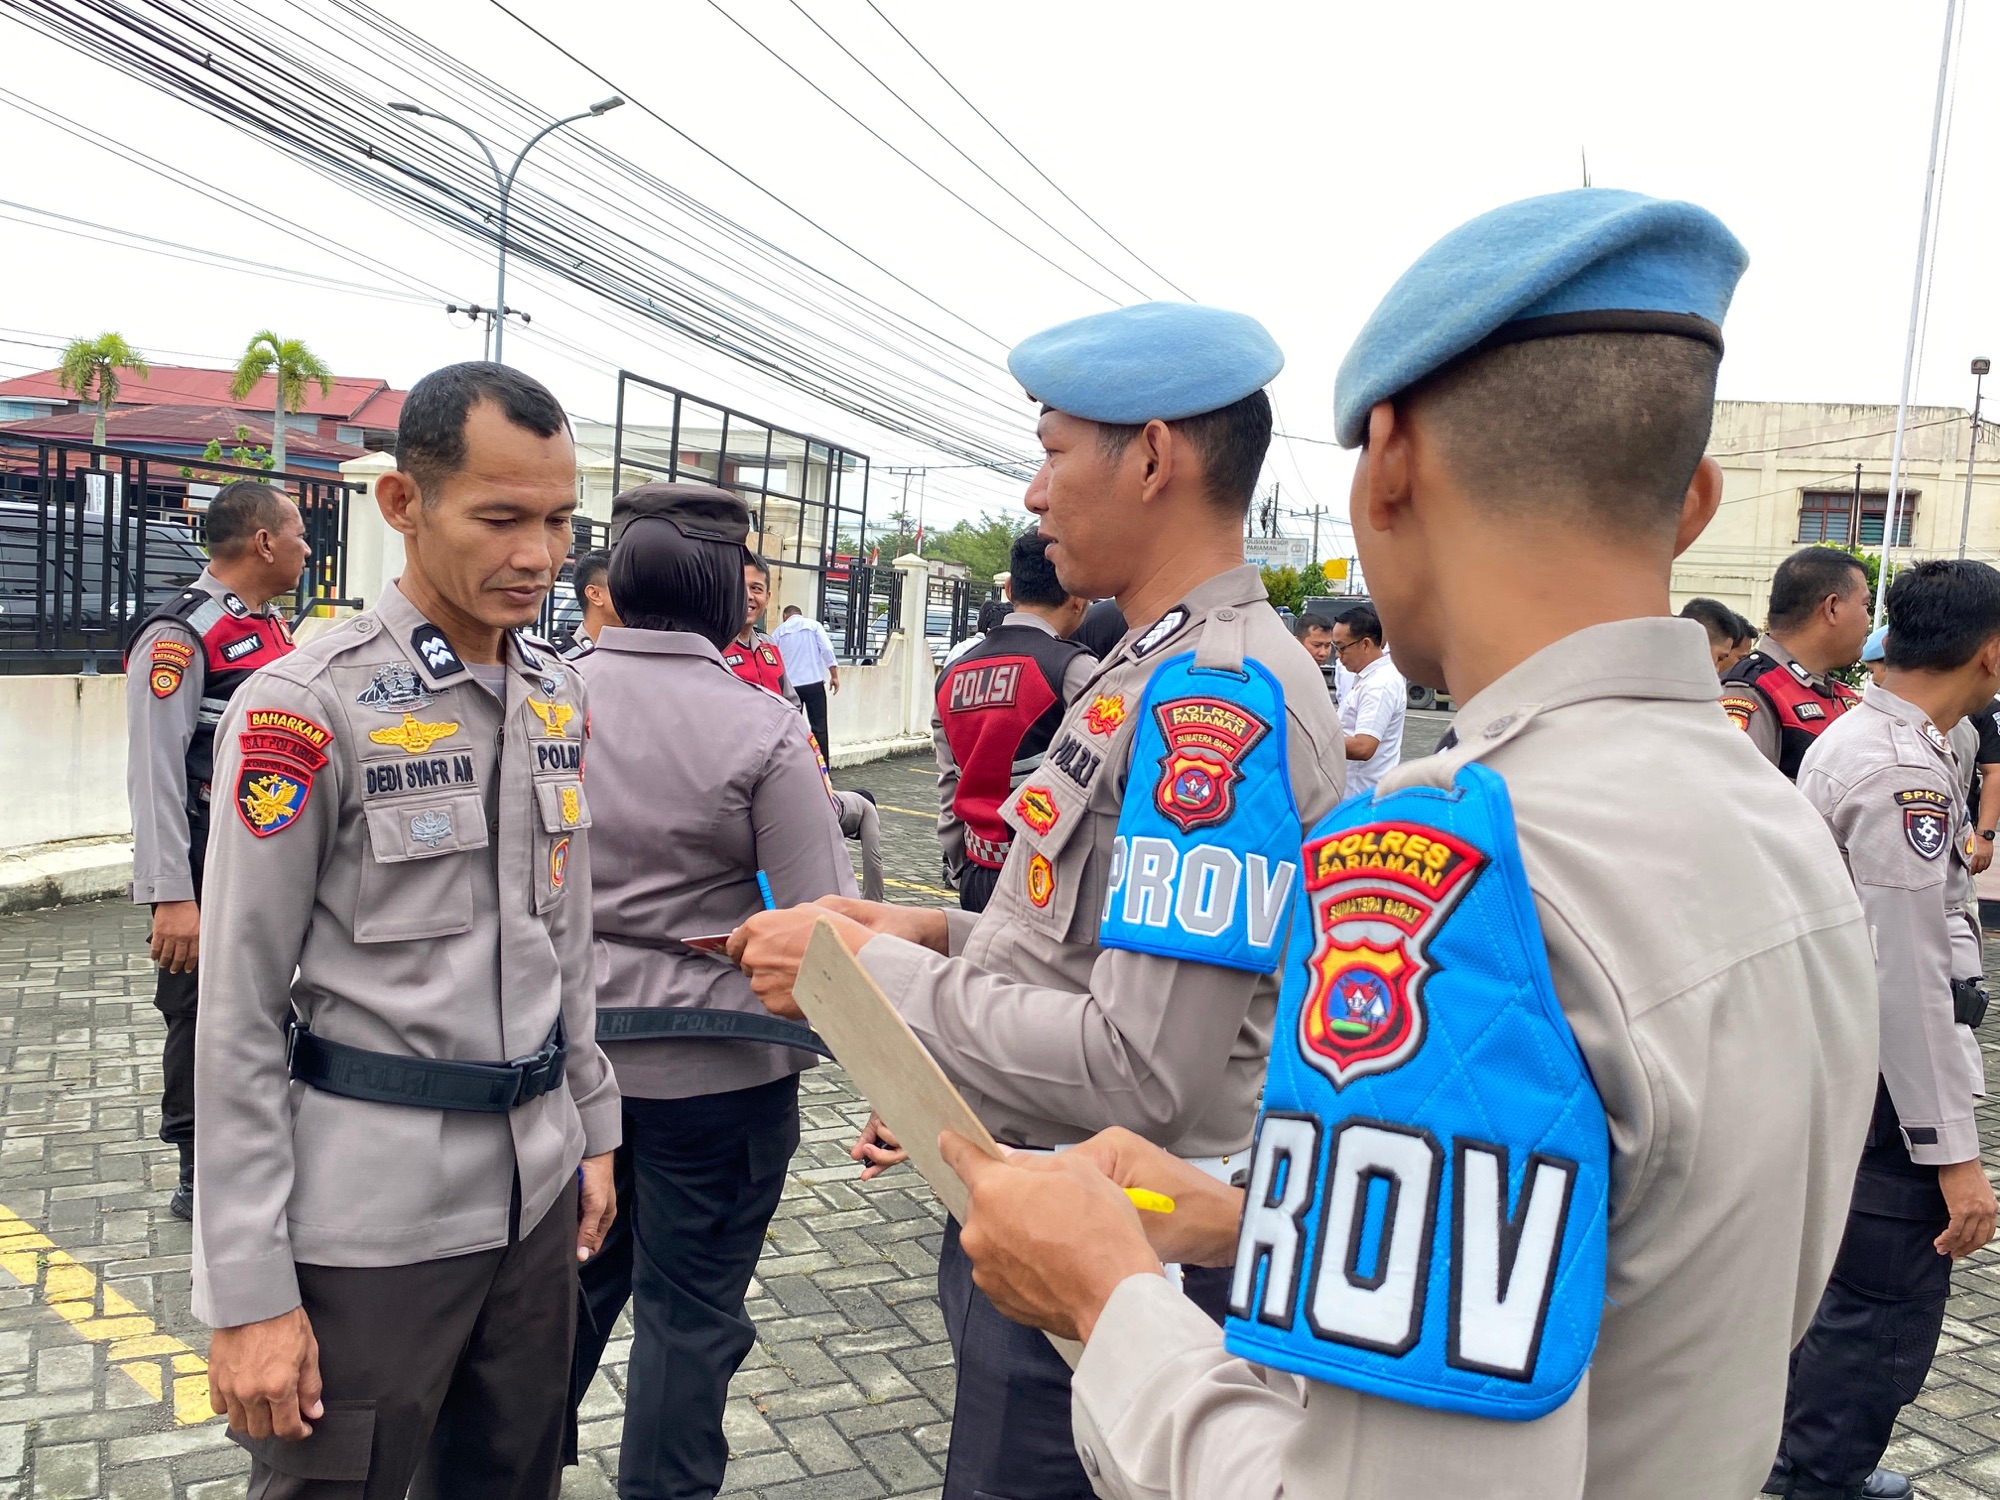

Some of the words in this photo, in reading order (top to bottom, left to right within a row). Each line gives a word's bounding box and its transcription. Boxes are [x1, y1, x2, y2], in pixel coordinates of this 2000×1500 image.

[227, 636, 259, 658] JIMMY
[950, 666, 1018, 709] POLISI
[252, 712, 325, 744] BAHARKAM
[1172, 705, 1248, 728] POLRES
[1173, 713, 1244, 737] PARIAMAN
[538, 744, 580, 770] POLRI
[1177, 733, 1213, 745] SUMATERA
[1213, 739, 1235, 755] BARAT
[1050, 733, 1101, 789] POLRI
[367, 765, 403, 794] DEDI
[1903, 790, 1946, 804] SPKT
[1318, 830, 1452, 871] POLRES
[1317, 852, 1443, 887] PARIAMAN
[1101, 835, 1296, 948] PROV
[1329, 896, 1383, 921] SUMATERA
[1383, 898, 1422, 925] BARAT
[672, 1014, 737, 1032] POLRI
